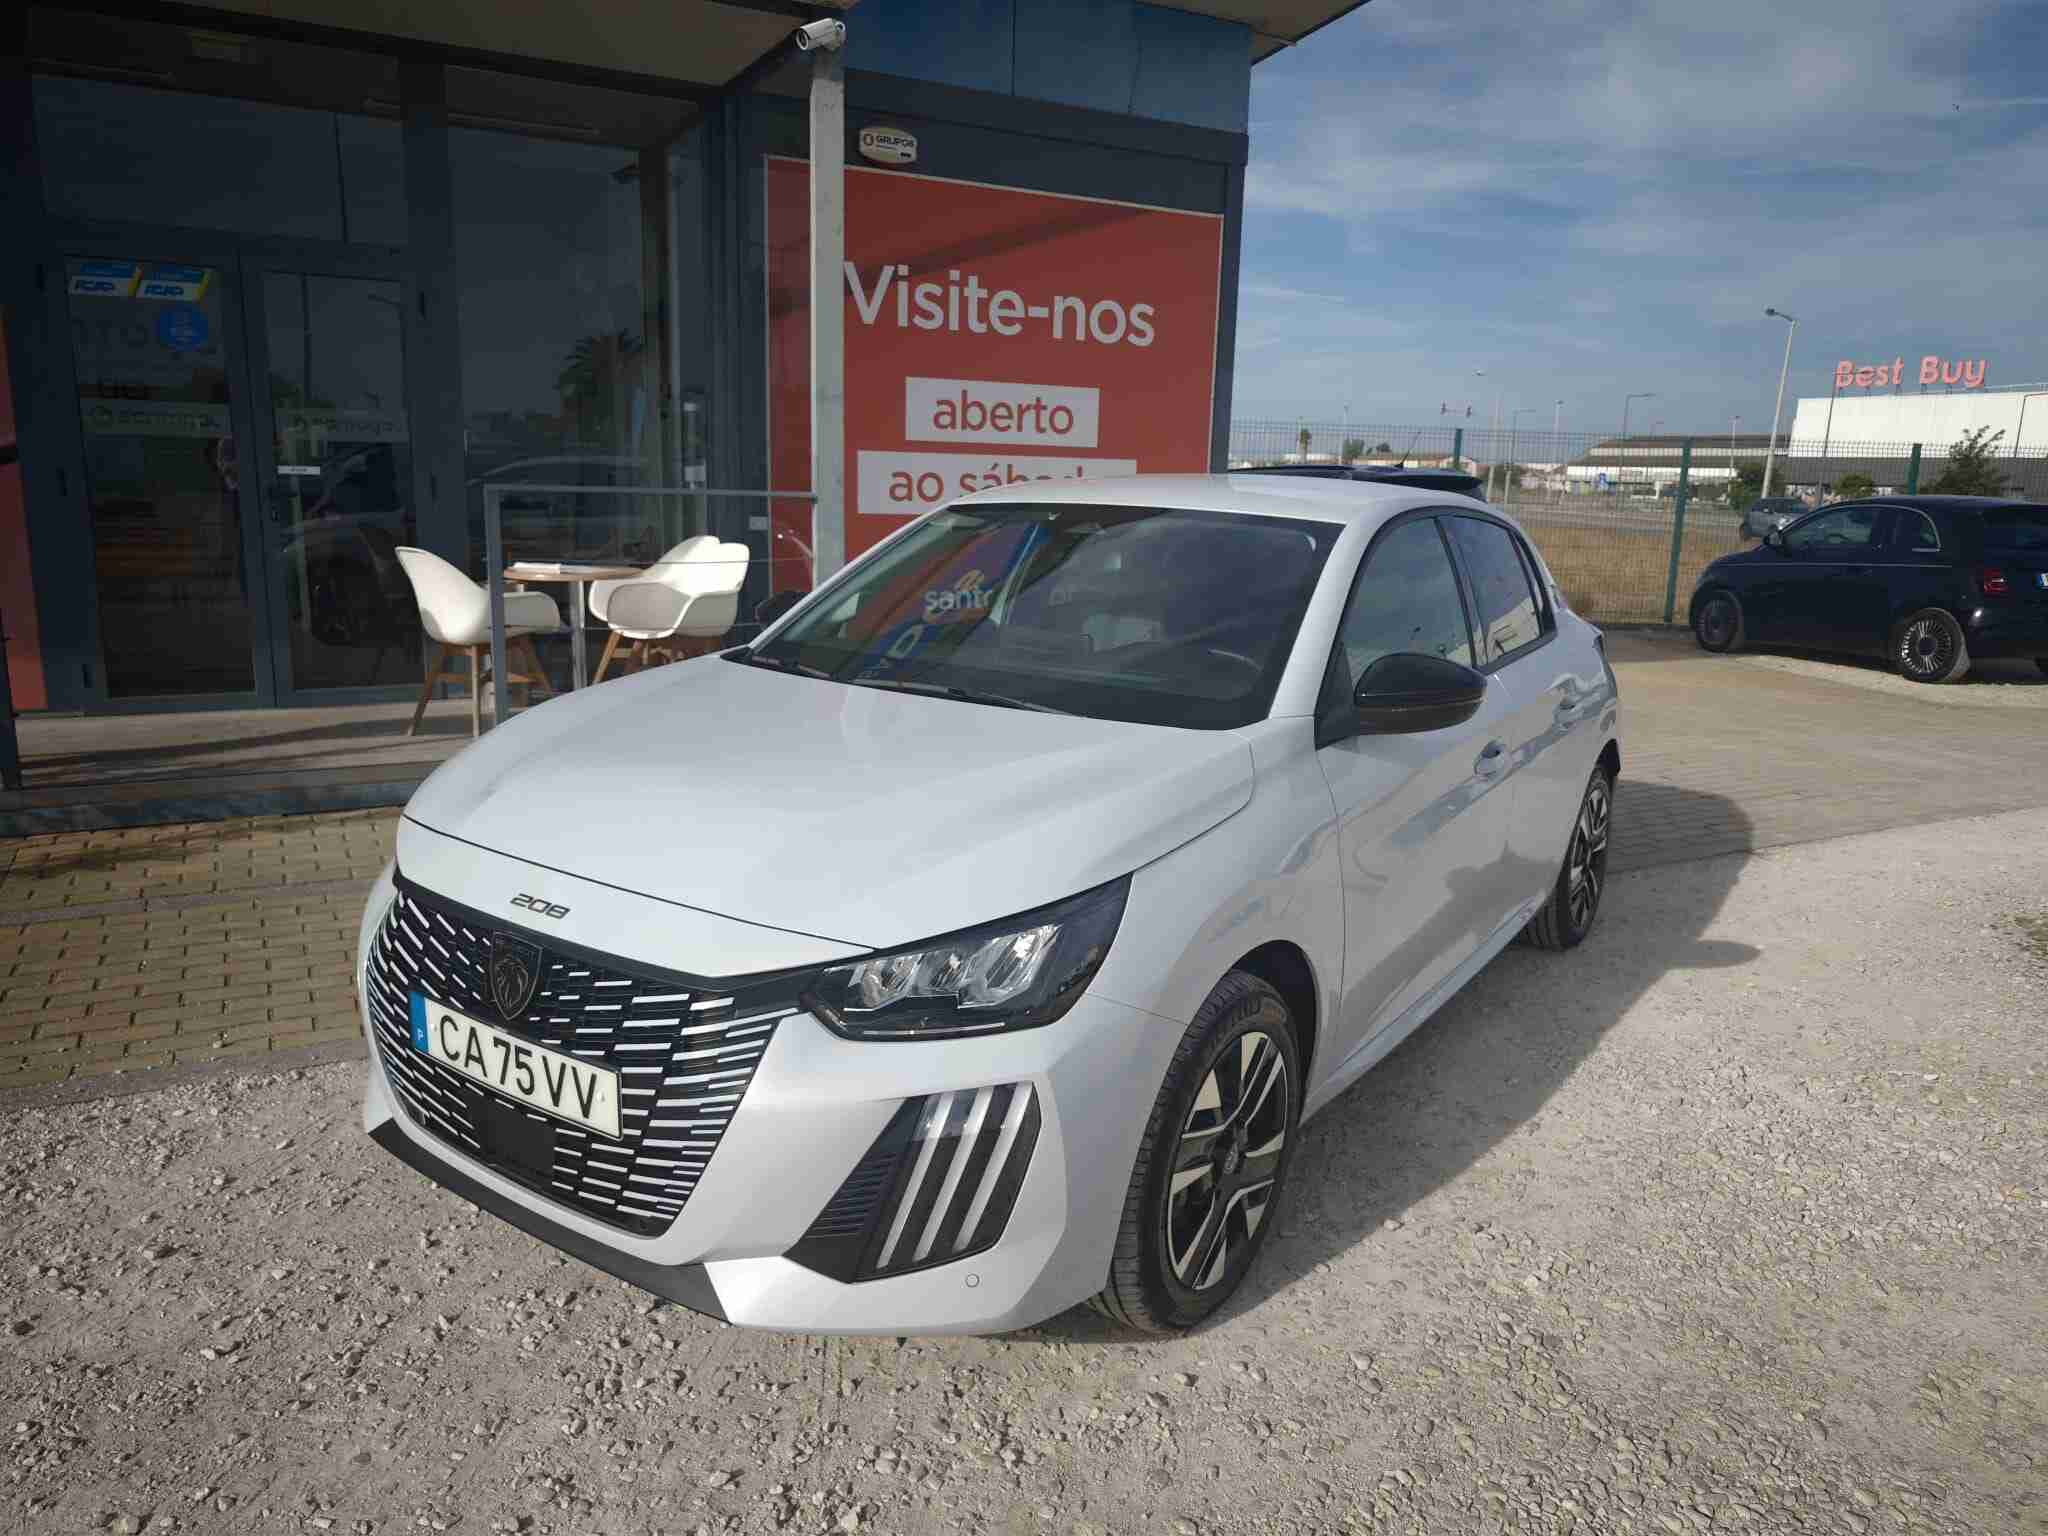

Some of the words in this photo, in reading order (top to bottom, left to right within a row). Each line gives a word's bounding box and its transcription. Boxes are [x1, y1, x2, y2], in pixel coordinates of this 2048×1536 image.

[843, 261, 1155, 347] Visite-nos
[1836, 355, 1904, 387] Best
[1920, 355, 1985, 388] Buy
[933, 389, 1074, 434] aberto
[889, 471, 944, 502] ao
[510, 893, 571, 919] 208
